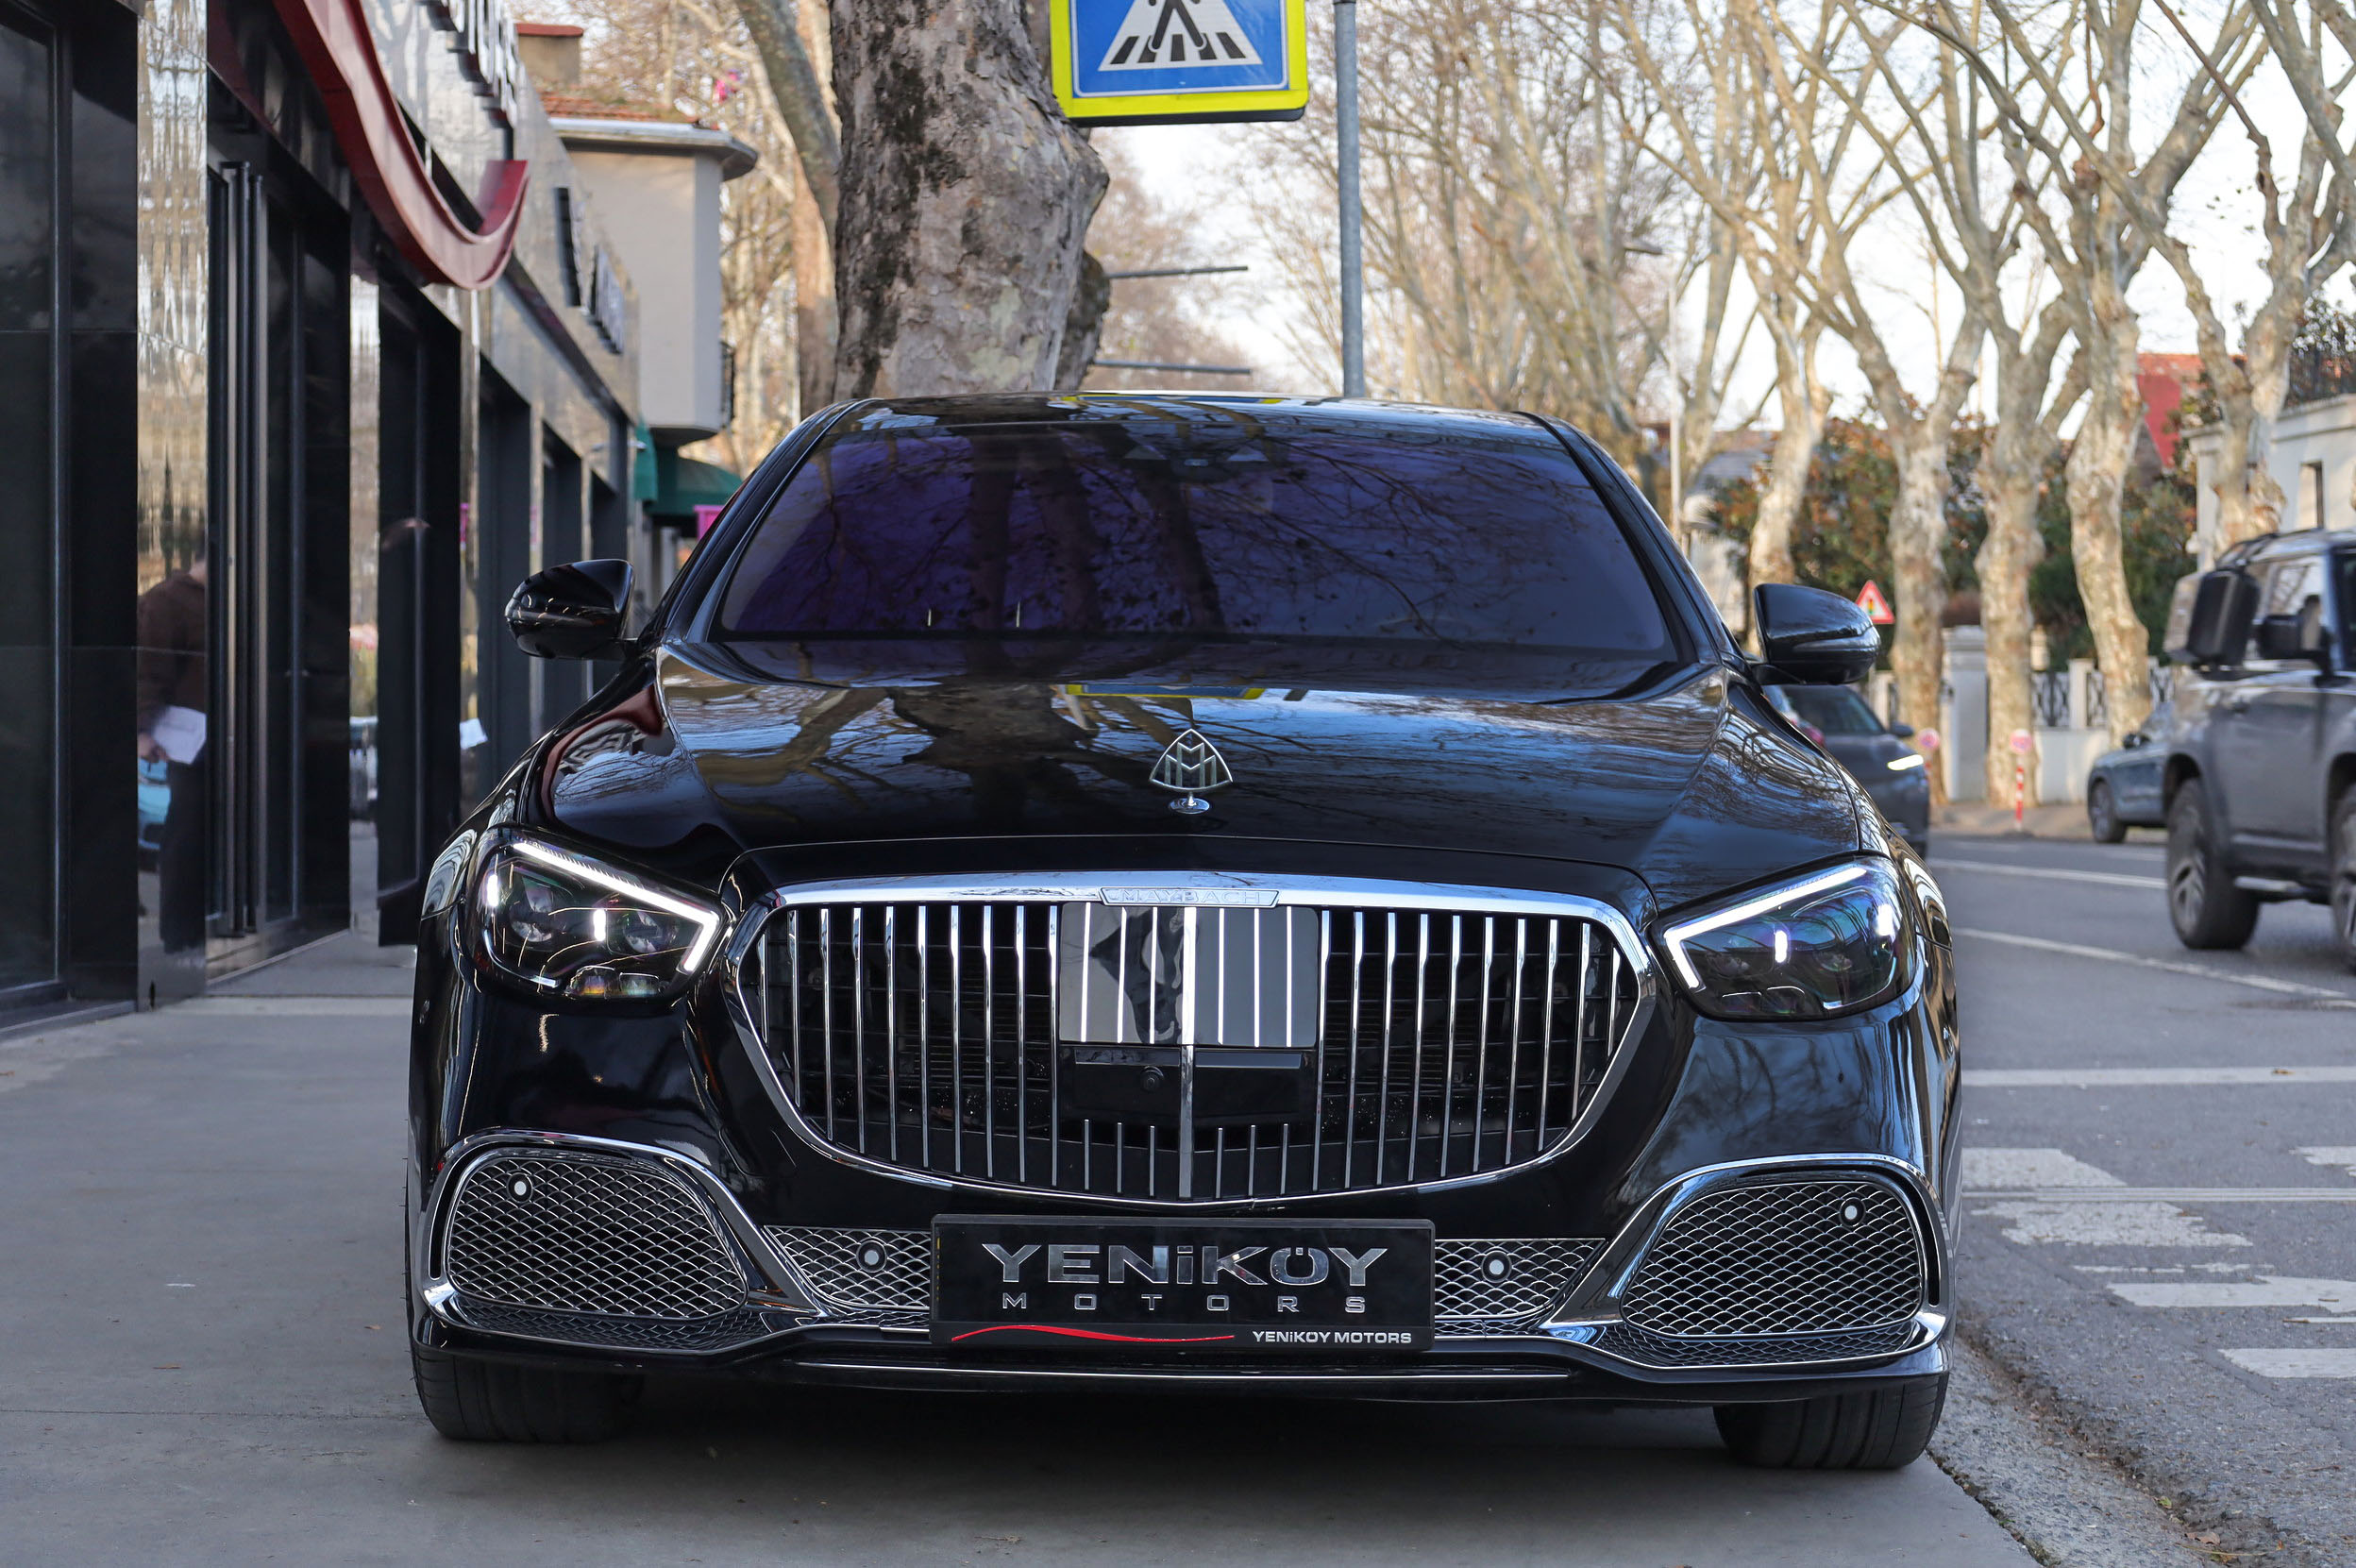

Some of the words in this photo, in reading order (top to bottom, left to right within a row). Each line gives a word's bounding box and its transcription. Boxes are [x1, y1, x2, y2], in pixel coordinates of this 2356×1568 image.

[1120, 889, 1260, 904] MAYBACH
[1002, 1292, 1366, 1313] MOTORS
[1334, 1332, 1412, 1343] MOTORS
